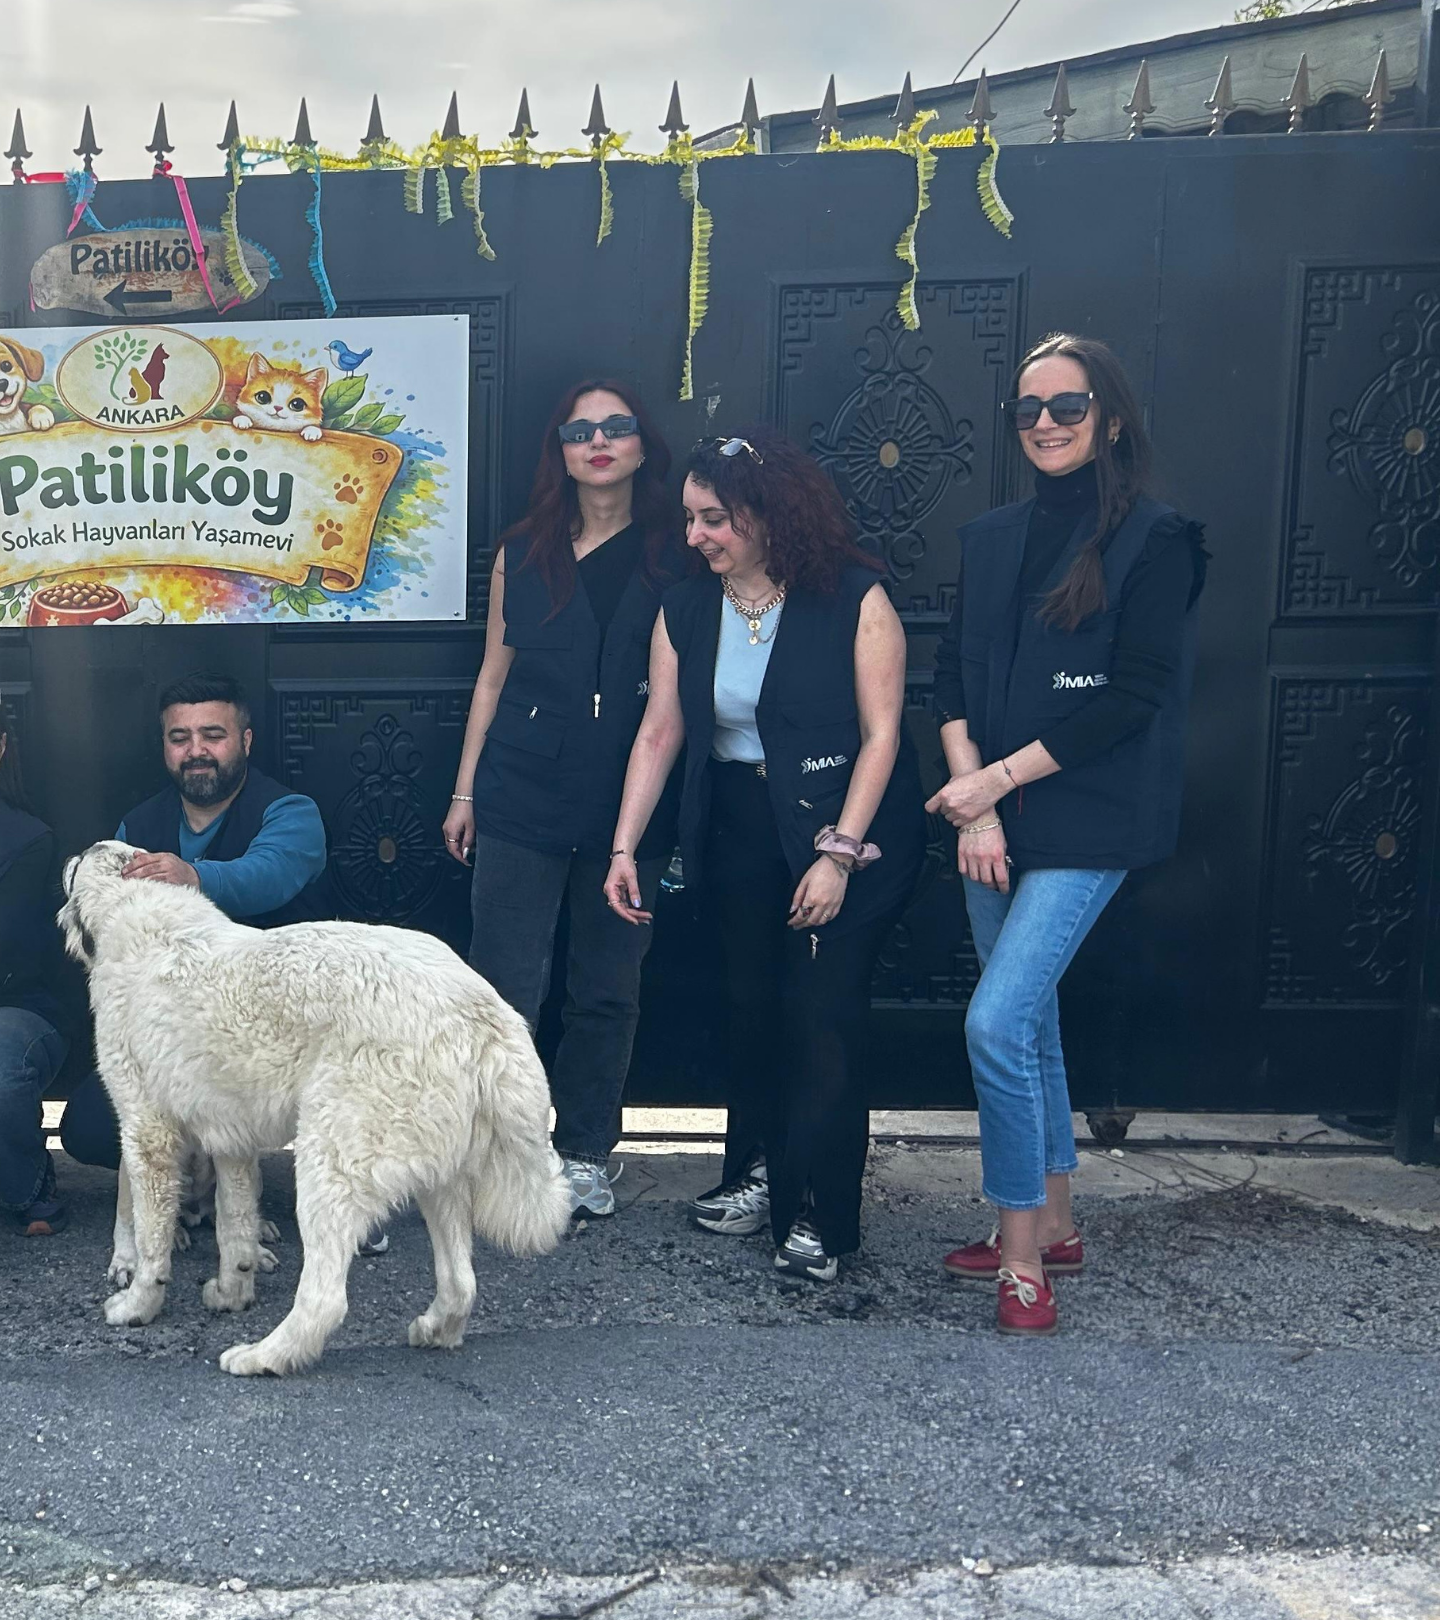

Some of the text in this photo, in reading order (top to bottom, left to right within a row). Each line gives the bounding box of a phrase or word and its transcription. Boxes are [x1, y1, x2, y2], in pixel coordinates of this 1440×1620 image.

[95, 404, 186, 425] ANKARA
[1, 518, 295, 553] Sokak Hayvanları Yaşamevi
